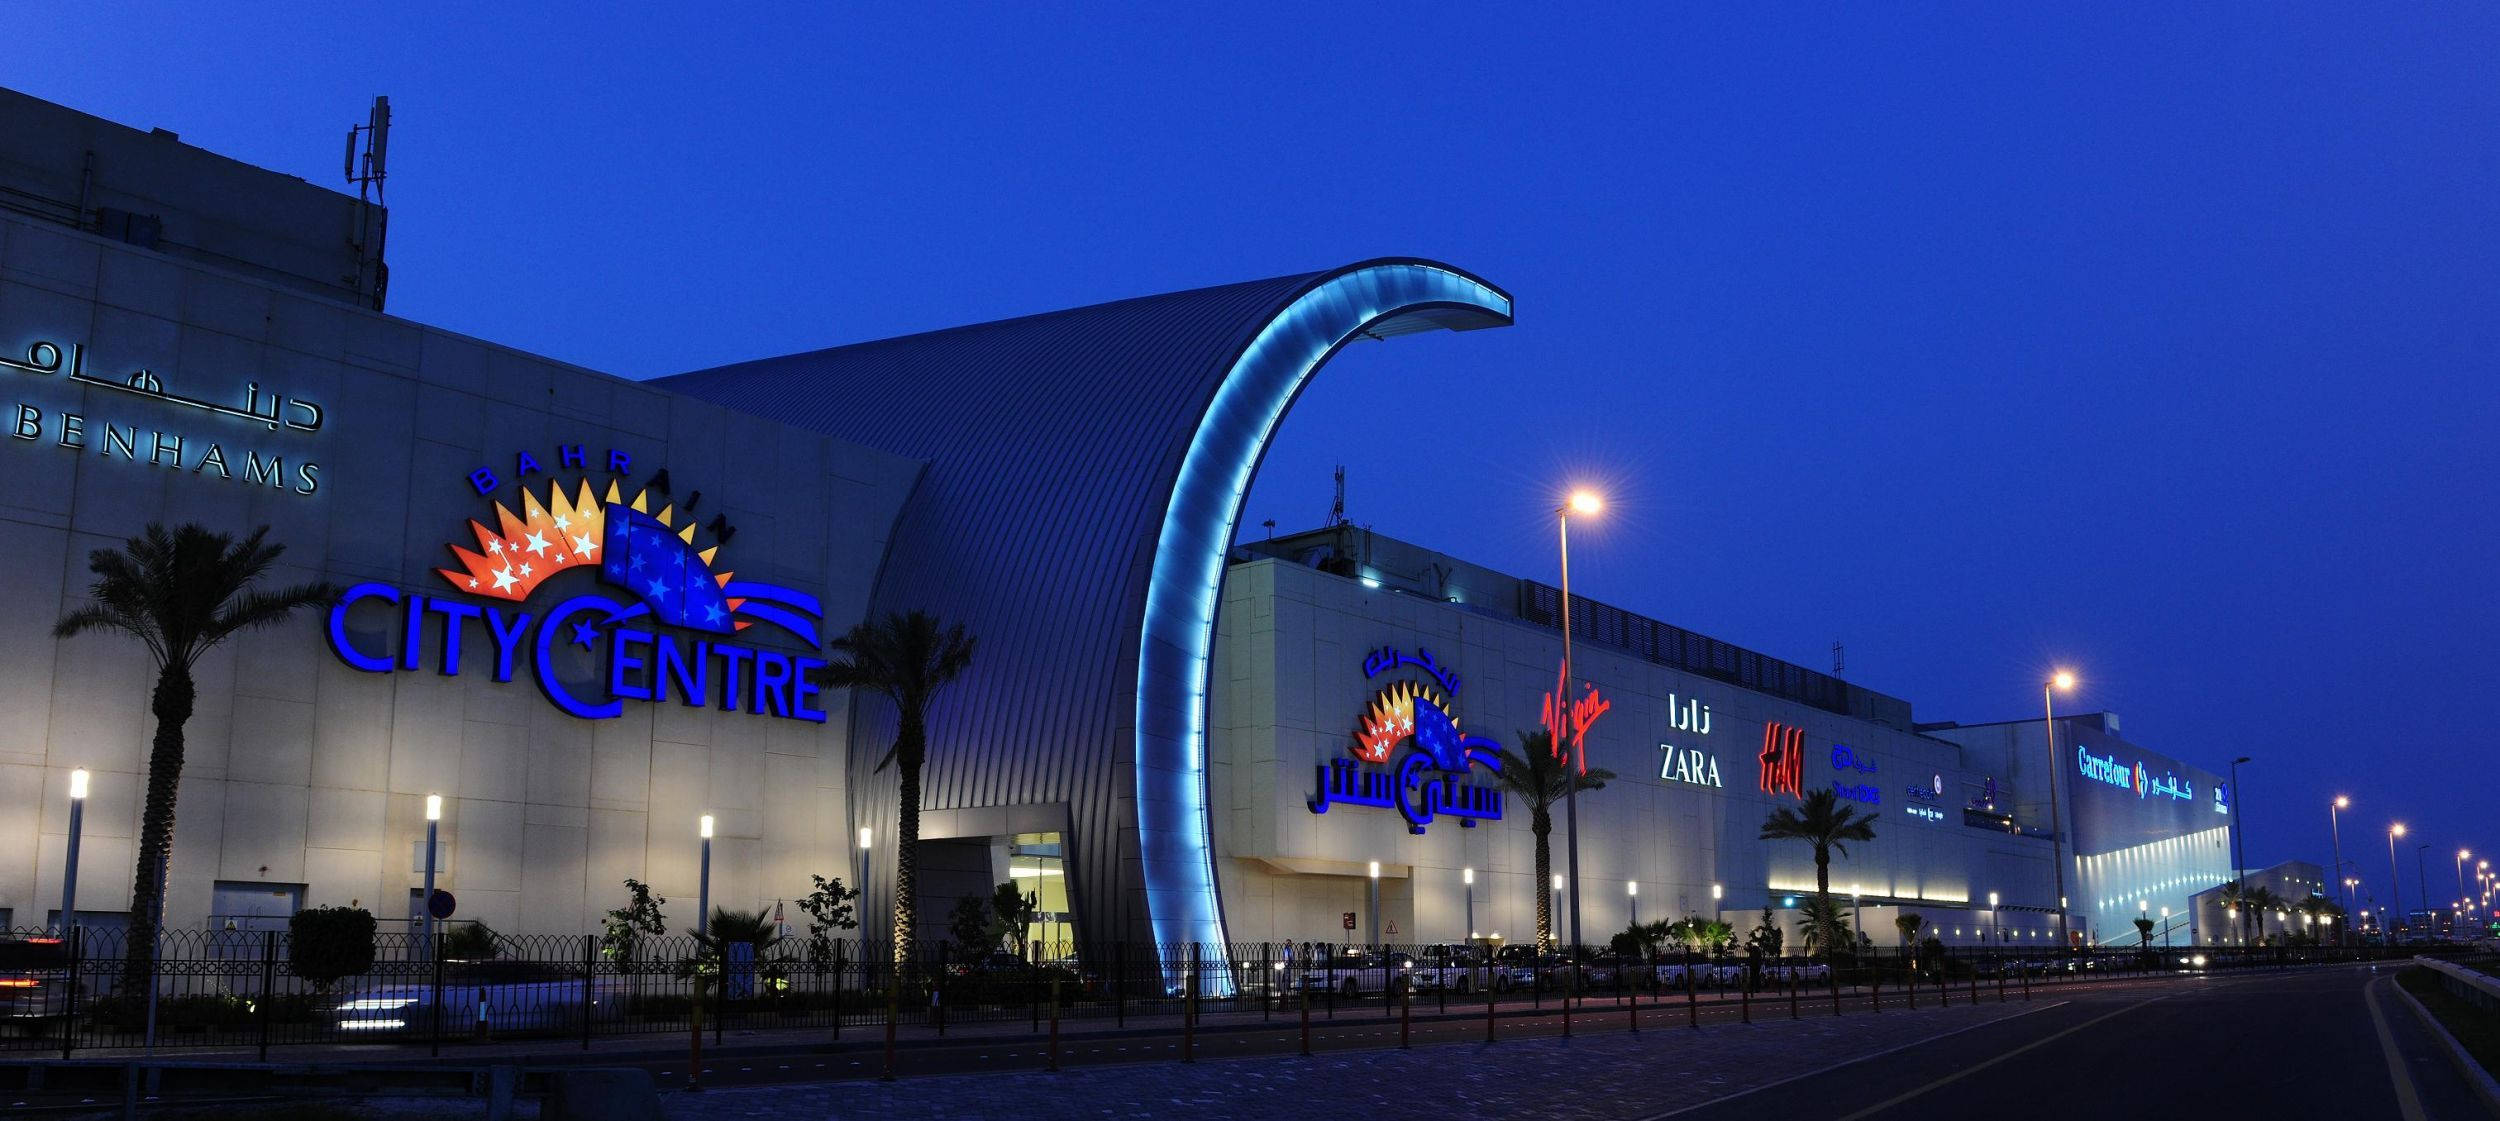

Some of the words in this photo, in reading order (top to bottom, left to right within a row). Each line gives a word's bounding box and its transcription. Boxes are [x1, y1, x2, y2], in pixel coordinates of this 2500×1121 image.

[13, 403, 321, 495] BENHAMS
[466, 443, 737, 546] BAHRAIN
[324, 582, 532, 683] CITY
[532, 594, 828, 724] CENTRE
[1362, 645, 1461, 698] البحرين
[1540, 659, 1610, 777] Vigin
[1668, 693, 1711, 735] زارا
[1660, 743, 1723, 788] ZARA
[1759, 720, 1805, 800] H&M
[2078, 744, 2131, 789] Carrefour
